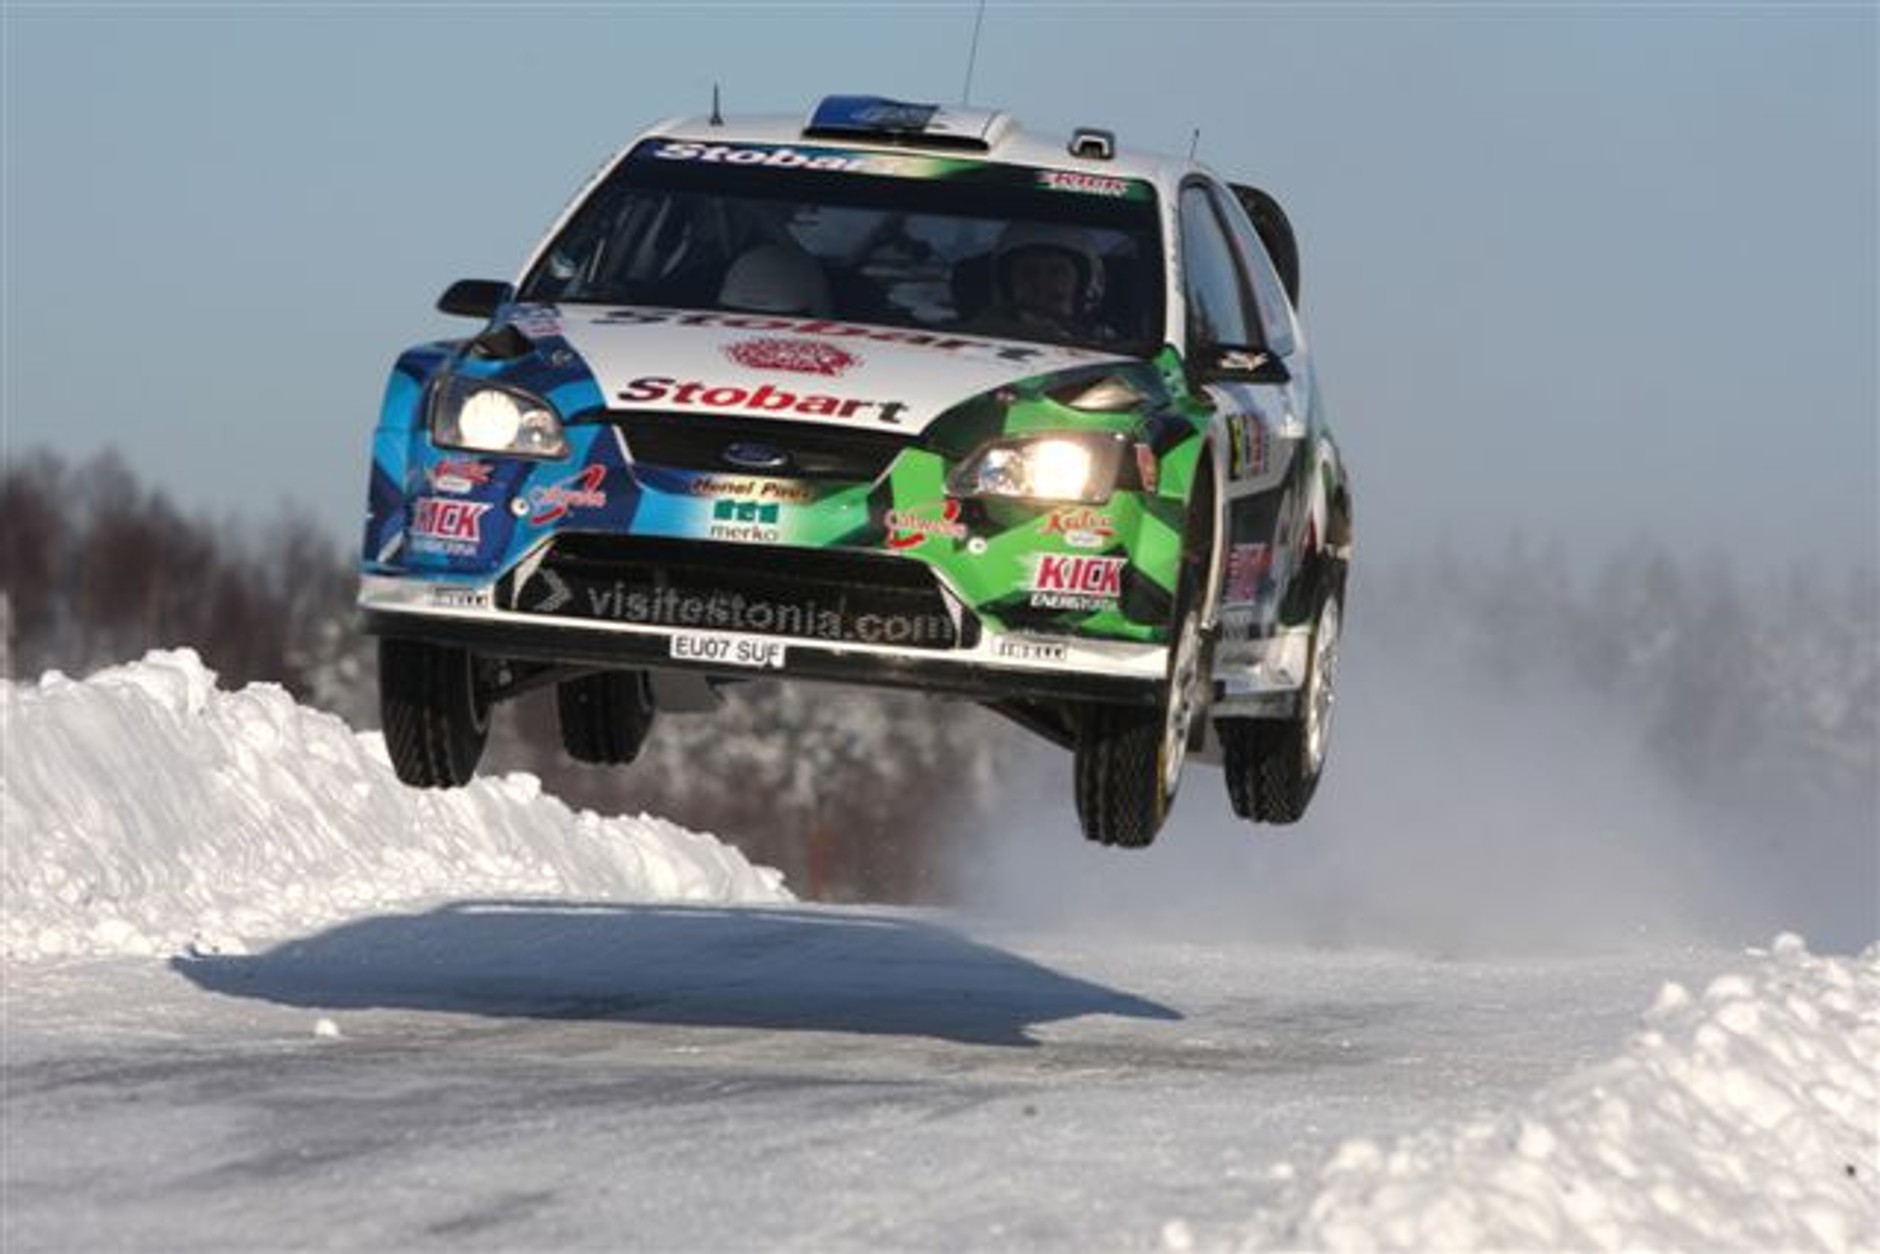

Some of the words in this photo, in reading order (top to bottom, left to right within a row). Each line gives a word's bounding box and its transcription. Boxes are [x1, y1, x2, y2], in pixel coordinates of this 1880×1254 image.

[617, 377, 908, 425] Stobart
[710, 525, 780, 541] merko
[1036, 554, 1128, 596] KICK
[587, 581, 953, 643] visitestonia.com
[676, 637, 730, 659] EU07
